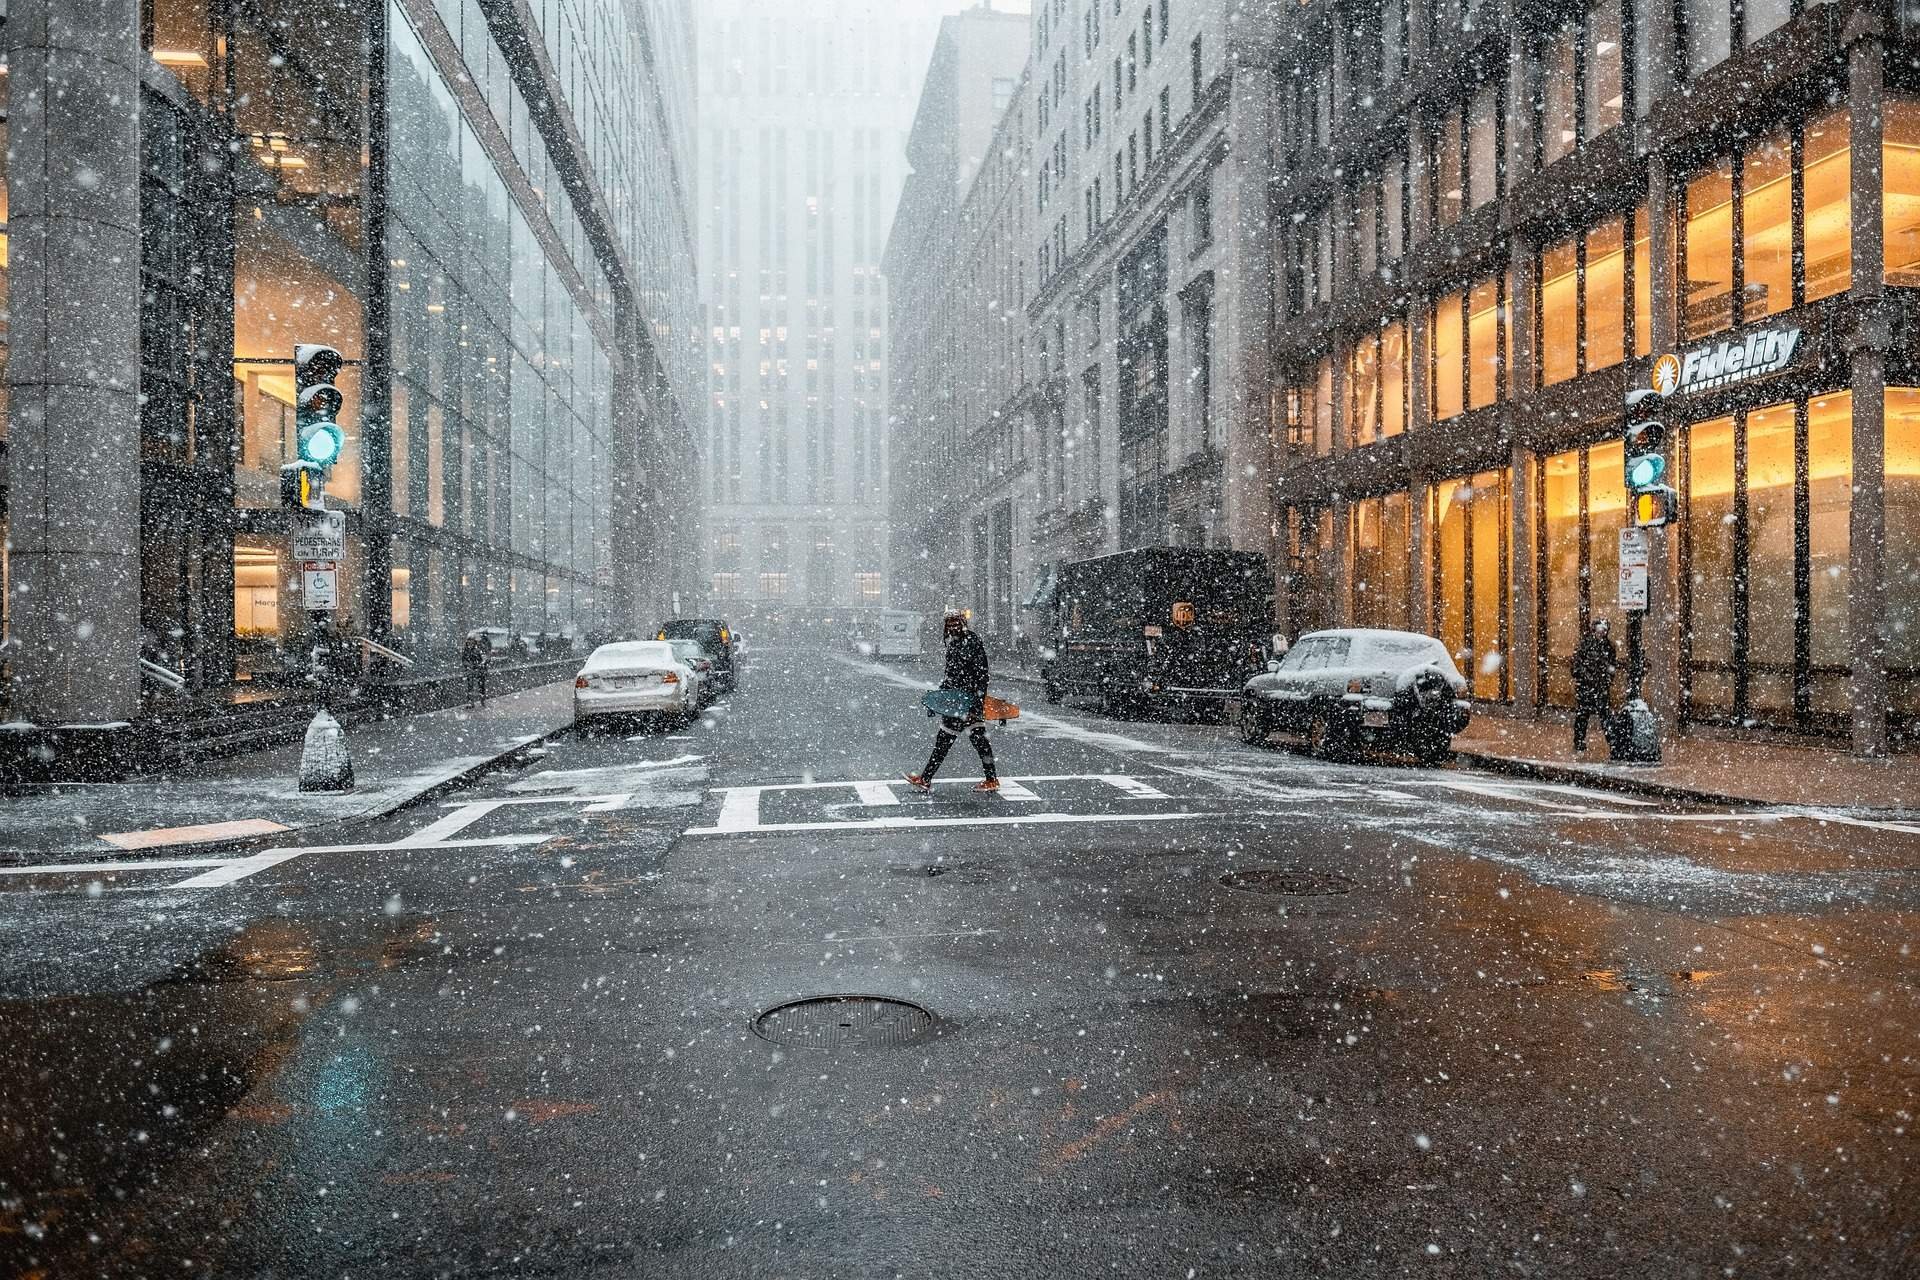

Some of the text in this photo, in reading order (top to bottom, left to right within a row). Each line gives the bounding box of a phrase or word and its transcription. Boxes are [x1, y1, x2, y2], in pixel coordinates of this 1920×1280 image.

[1680, 328, 1800, 386] Fidelity
[1684, 363, 1776, 394] INVESTMENTS
[295, 537, 341, 546] PEDESTRIANS
[311, 547, 340, 557] TURNS
